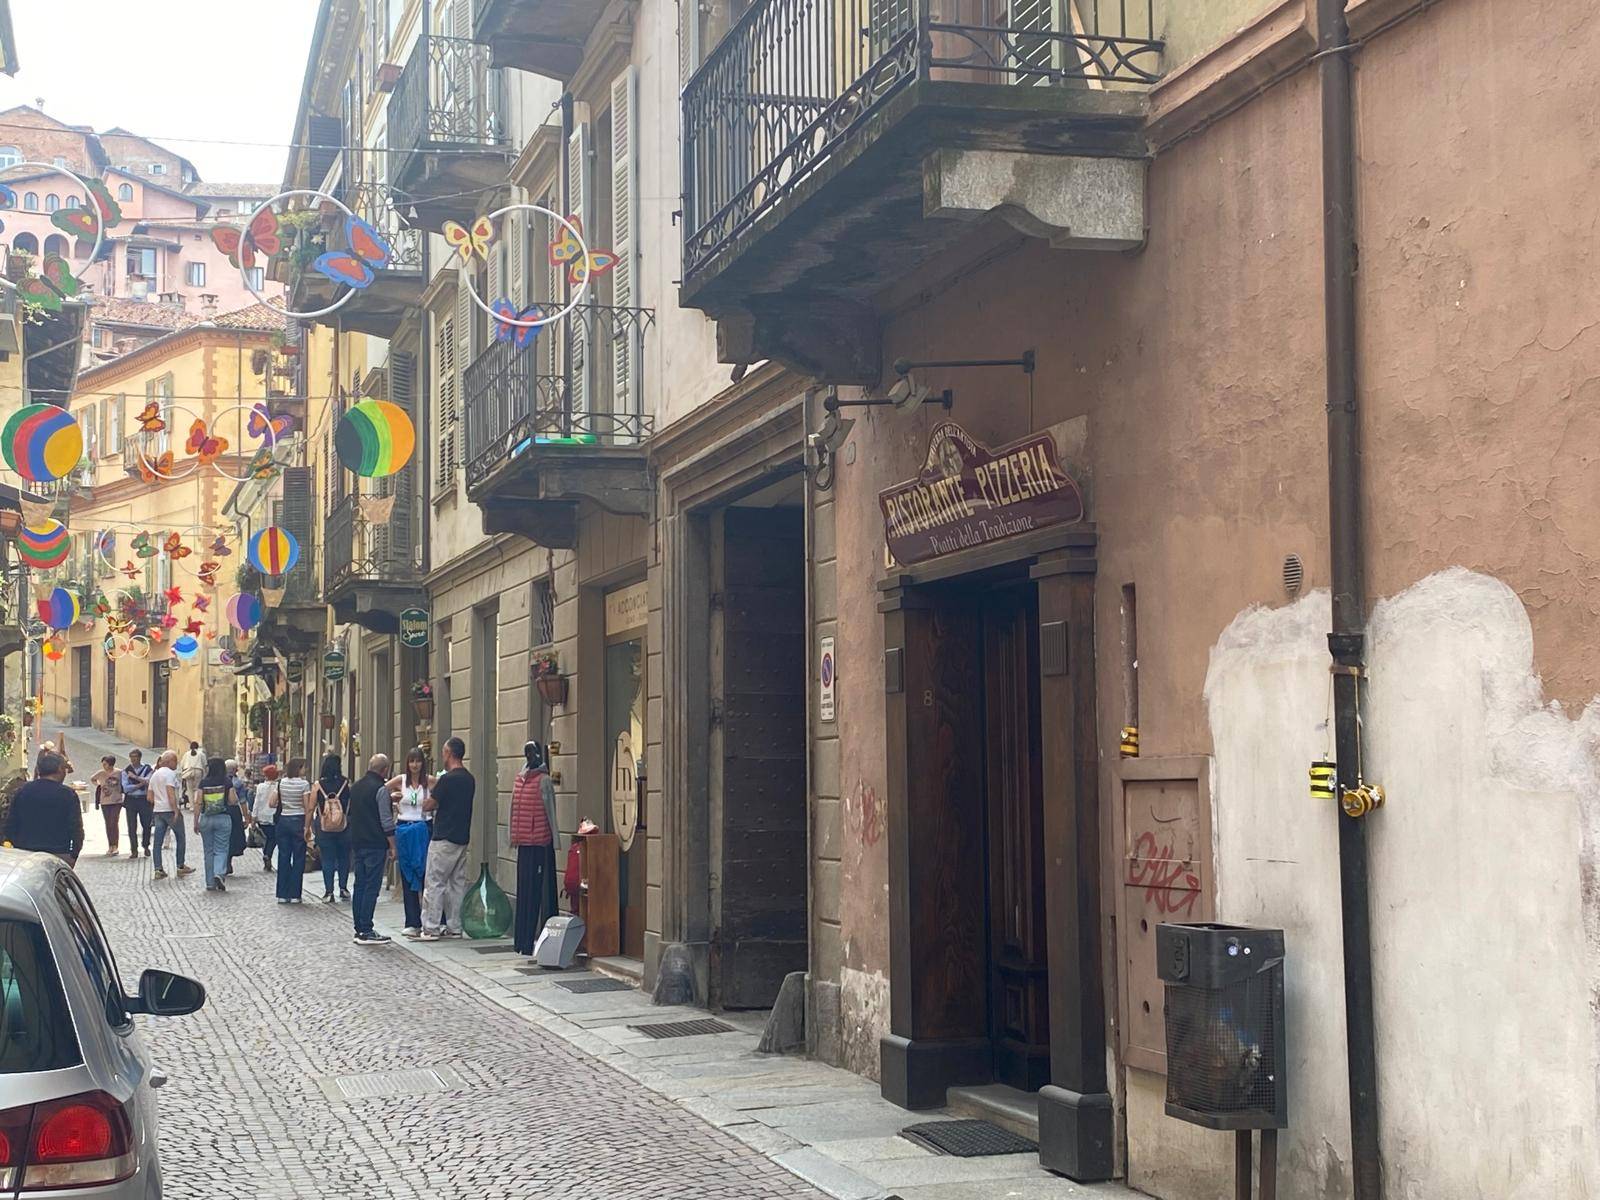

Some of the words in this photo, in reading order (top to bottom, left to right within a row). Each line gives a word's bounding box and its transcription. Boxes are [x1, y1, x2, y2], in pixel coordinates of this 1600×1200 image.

[885, 474, 975, 537] RISTORANTE
[974, 444, 1059, 510] PIZZERIA
[929, 530, 960, 555] Piatti
[955, 522, 983, 548] della
[979, 512, 1034, 540] Tradizione
